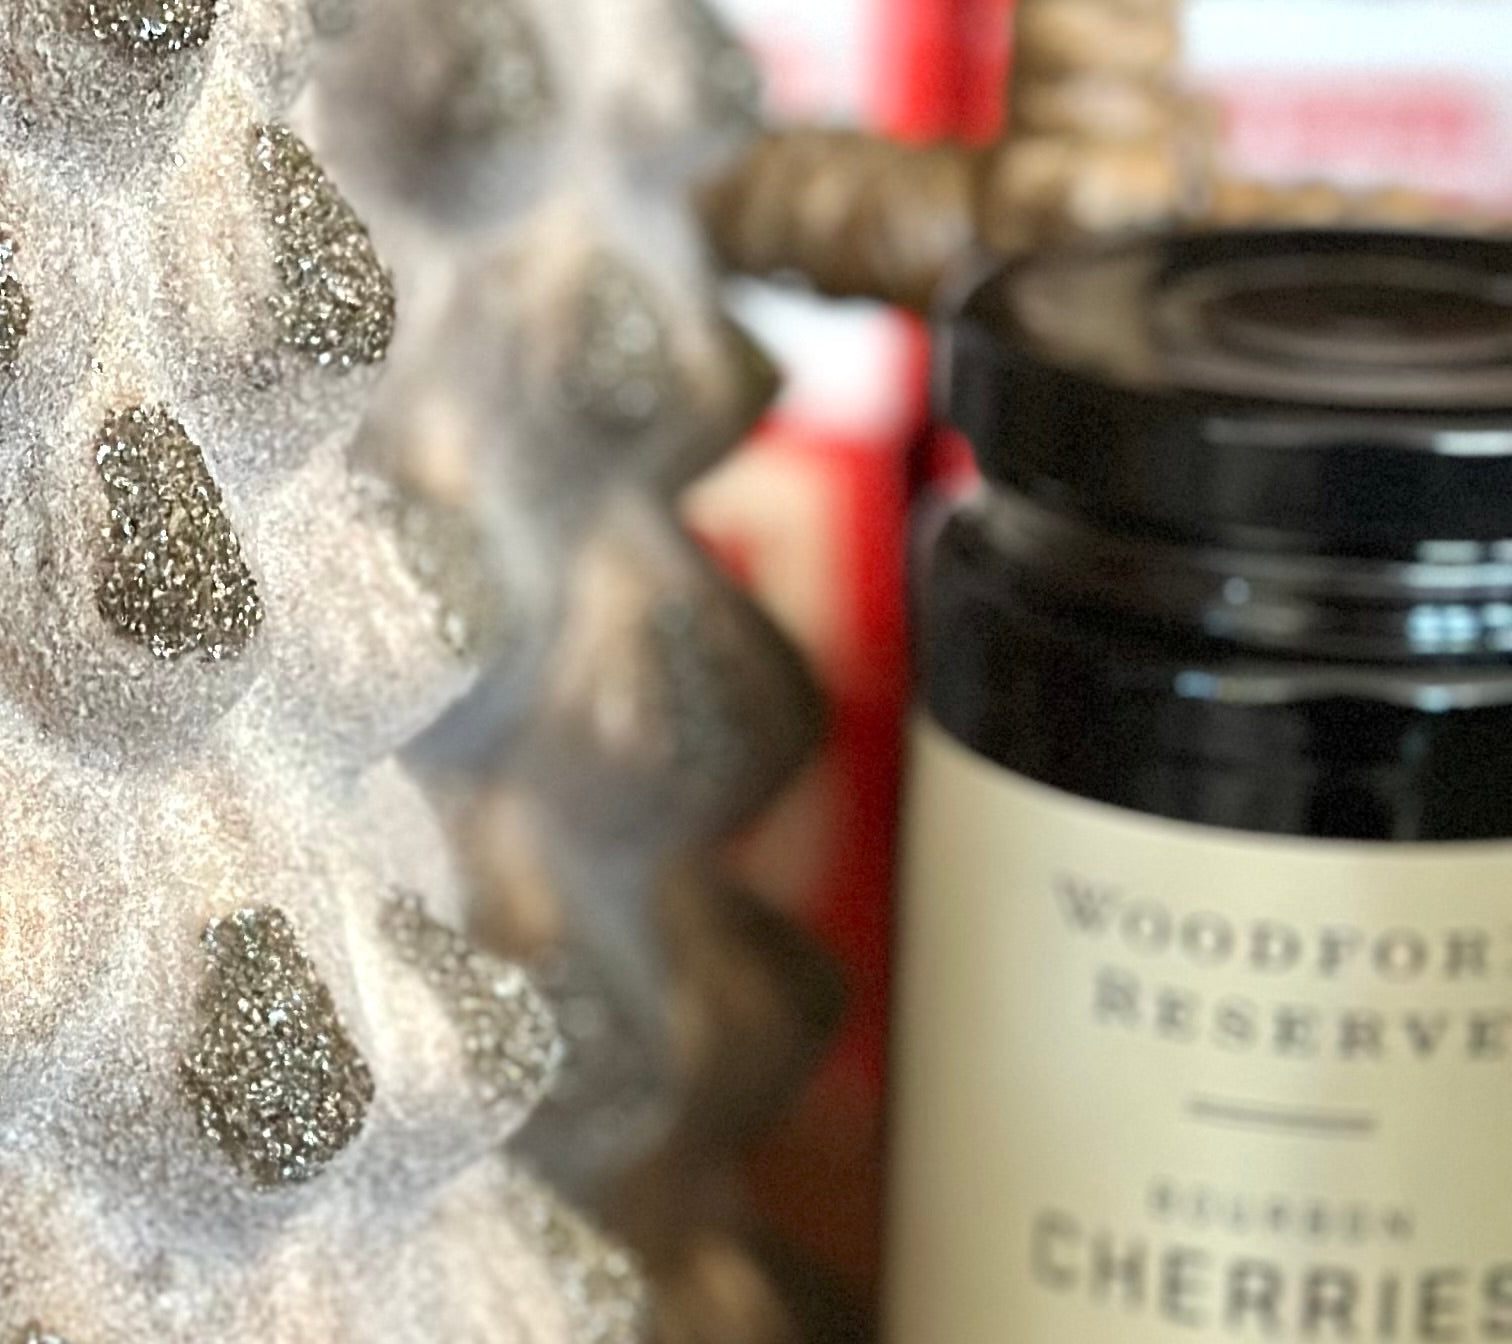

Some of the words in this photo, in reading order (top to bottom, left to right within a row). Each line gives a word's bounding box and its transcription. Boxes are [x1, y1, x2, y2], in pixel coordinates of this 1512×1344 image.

[1056, 872, 1512, 977] WOODFOR
[1095, 966, 1509, 1057] RESERVE
[1033, 1210, 1512, 1344] CHERRIES
